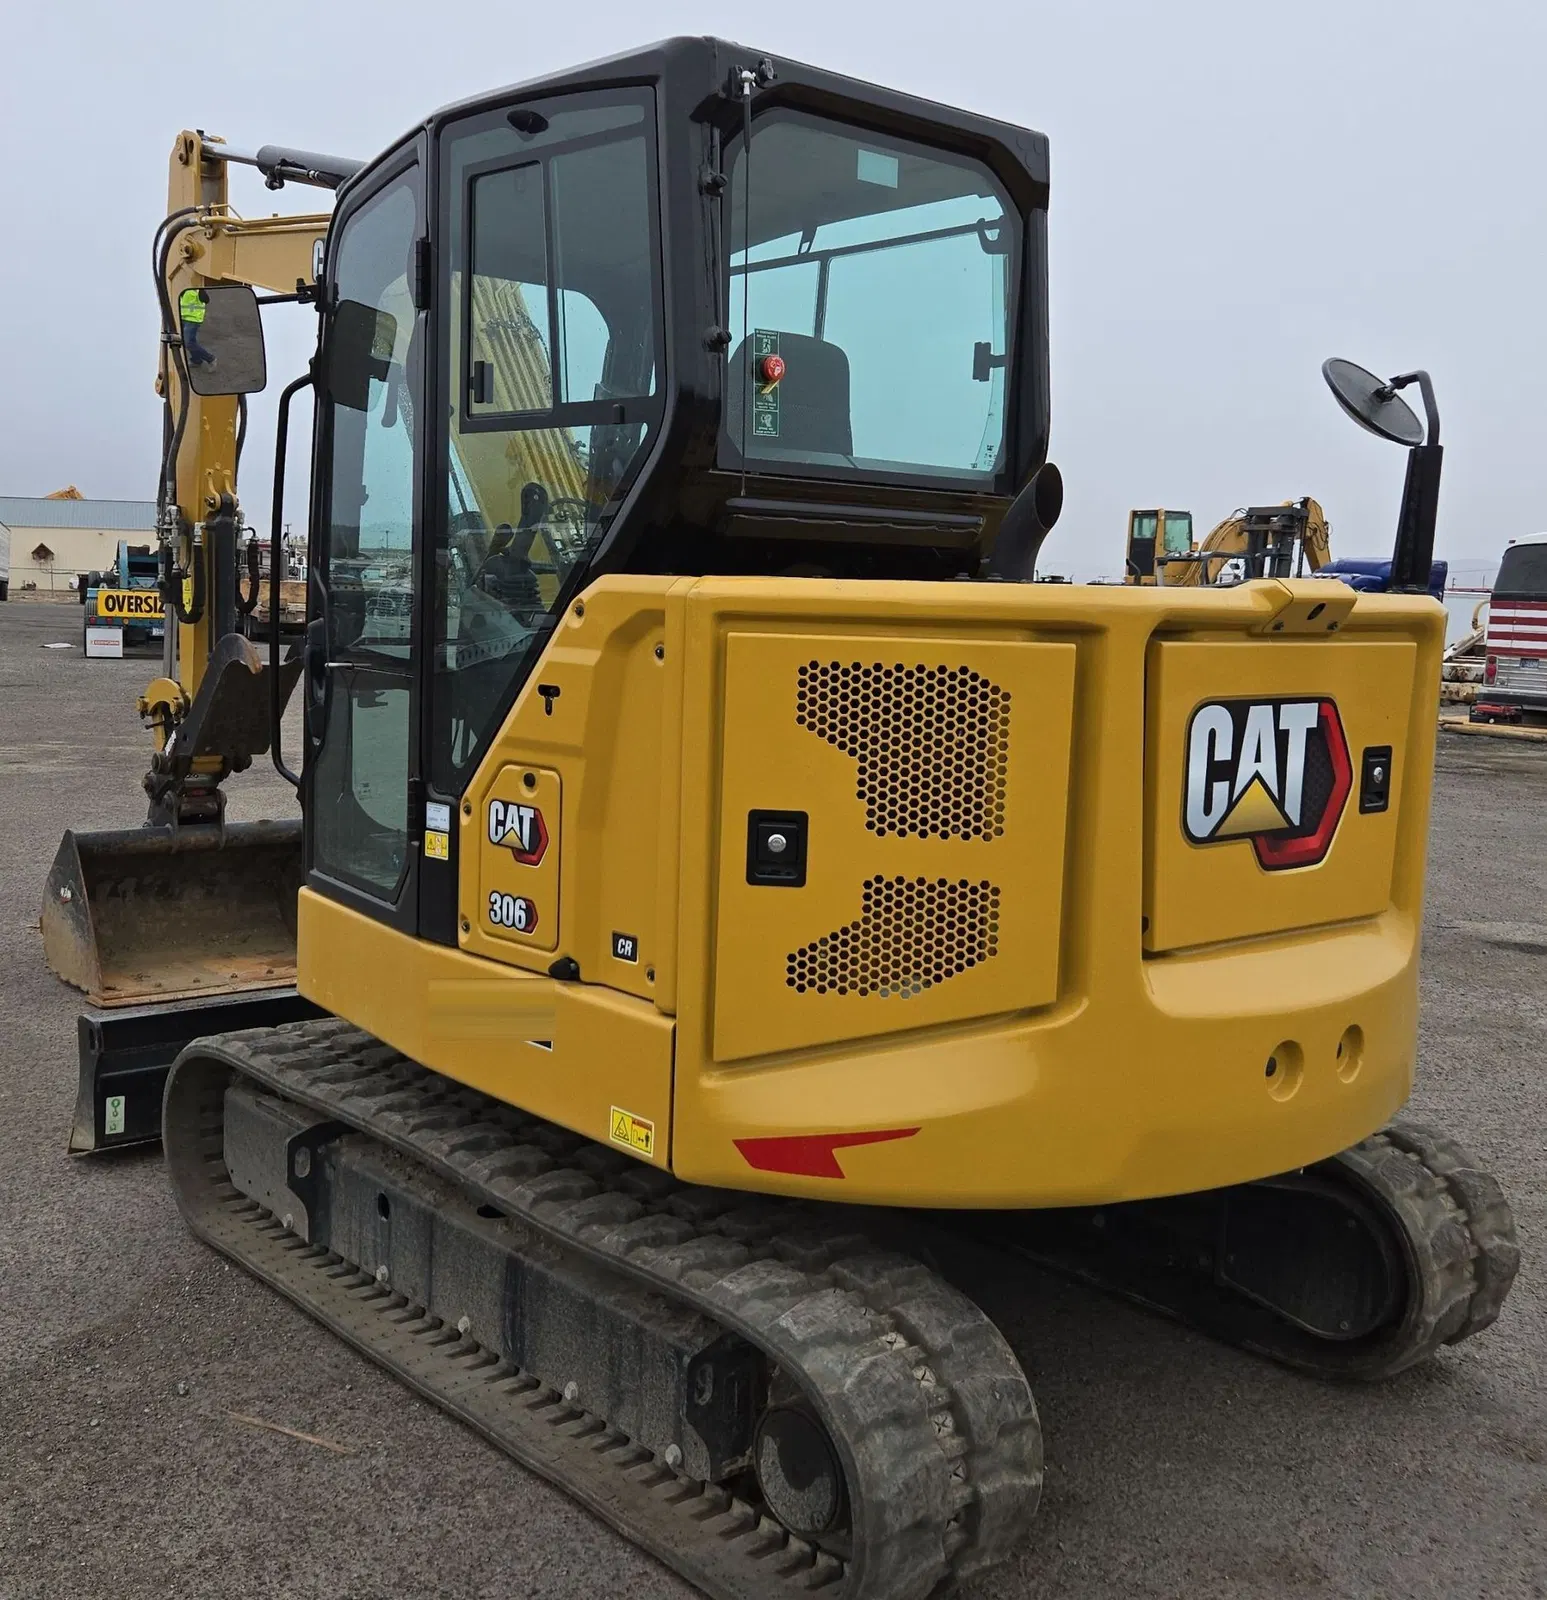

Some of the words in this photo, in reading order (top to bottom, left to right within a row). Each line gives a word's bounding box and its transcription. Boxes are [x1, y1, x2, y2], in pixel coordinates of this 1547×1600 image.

[105, 594, 165, 613] OVERSIZ
[1186, 702, 1319, 838] CAT
[489, 800, 535, 852] CAT
[490, 892, 527, 930] 306
[617, 938, 632, 956] CR
